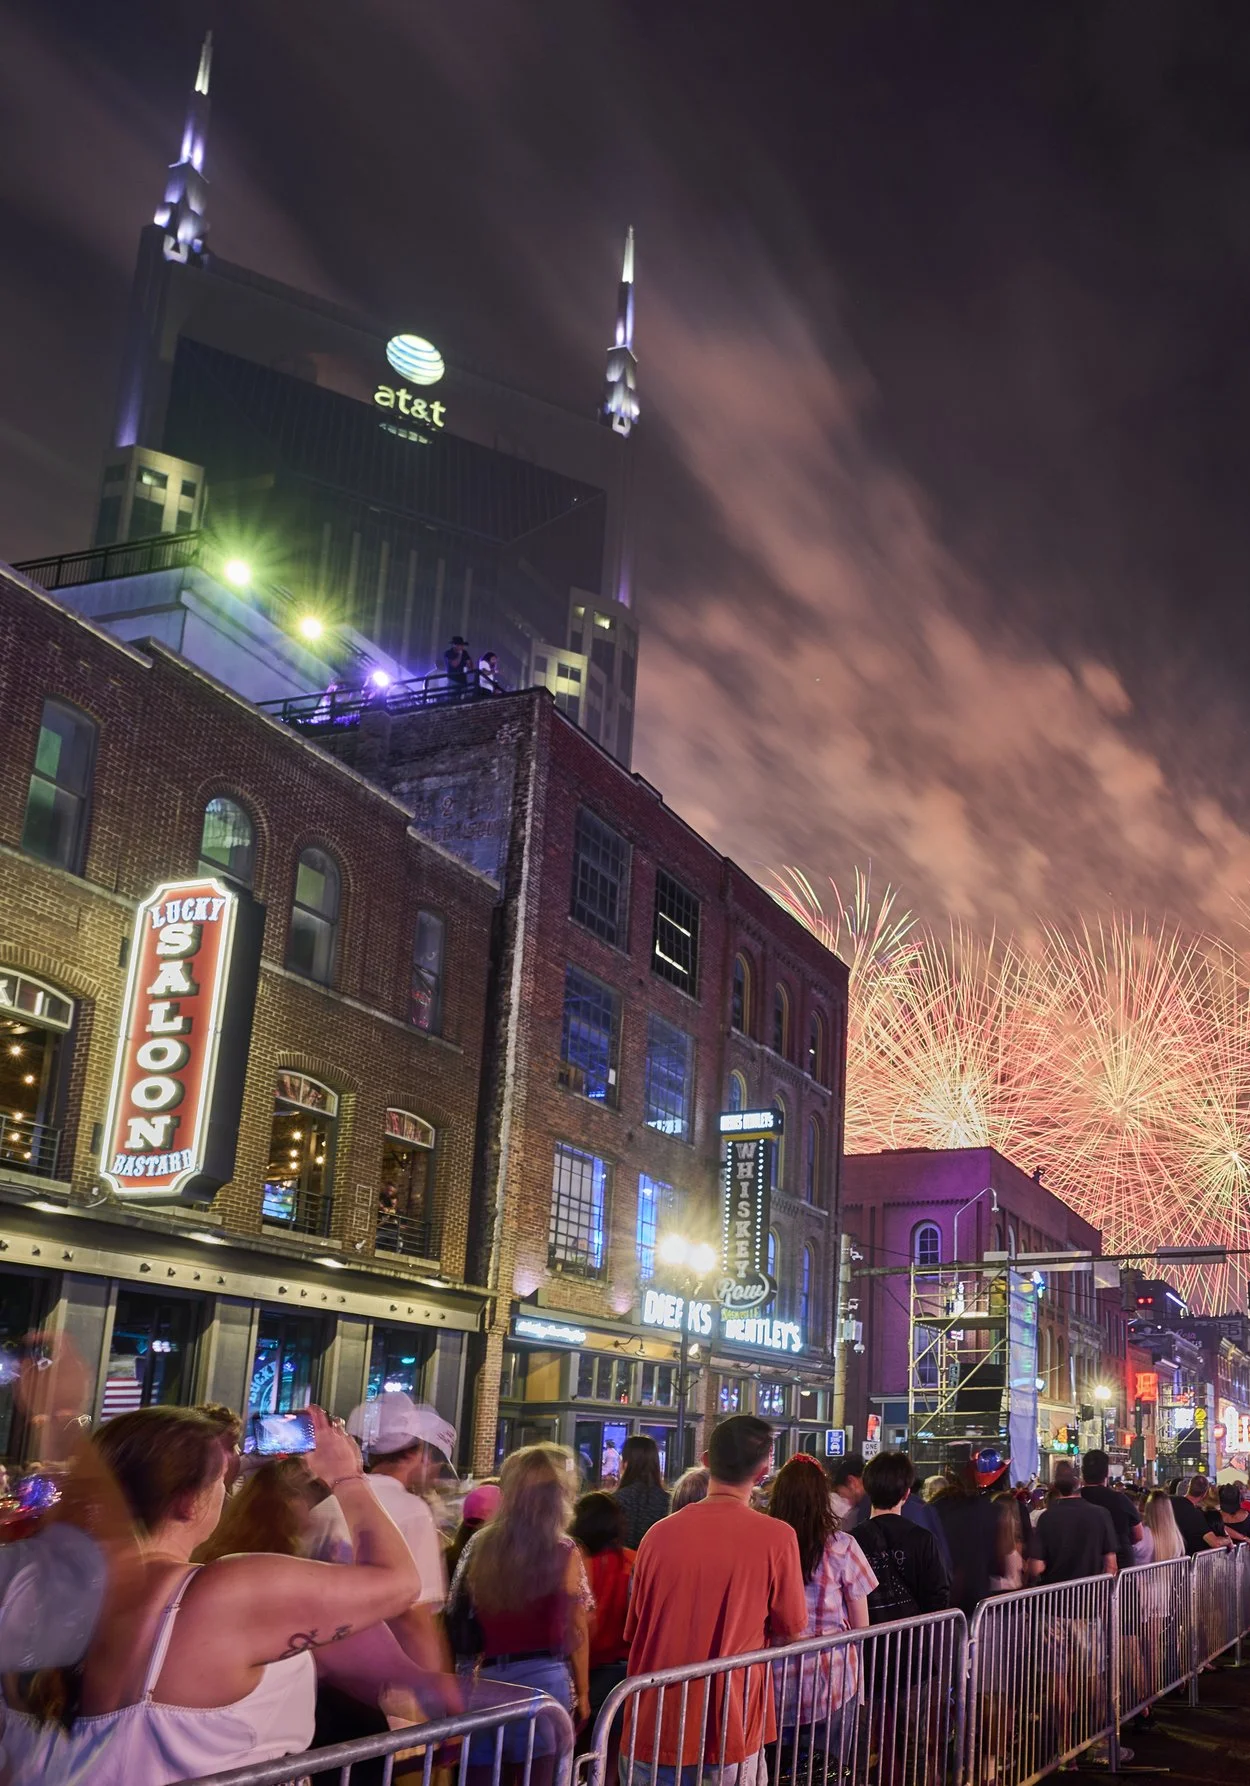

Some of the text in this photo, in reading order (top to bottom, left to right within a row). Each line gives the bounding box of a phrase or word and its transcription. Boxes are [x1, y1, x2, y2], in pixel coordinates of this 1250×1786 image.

[374, 385, 447, 428] at&t
[150, 897, 226, 929] LUCKY
[124, 921, 195, 1151] SALOON
[110, 1148, 194, 1178] BASTARD
[735, 1142, 756, 1278] WHISKEY
[717, 1278, 766, 1308] Row
[725, 1317, 803, 1353] BENTLEY'S
